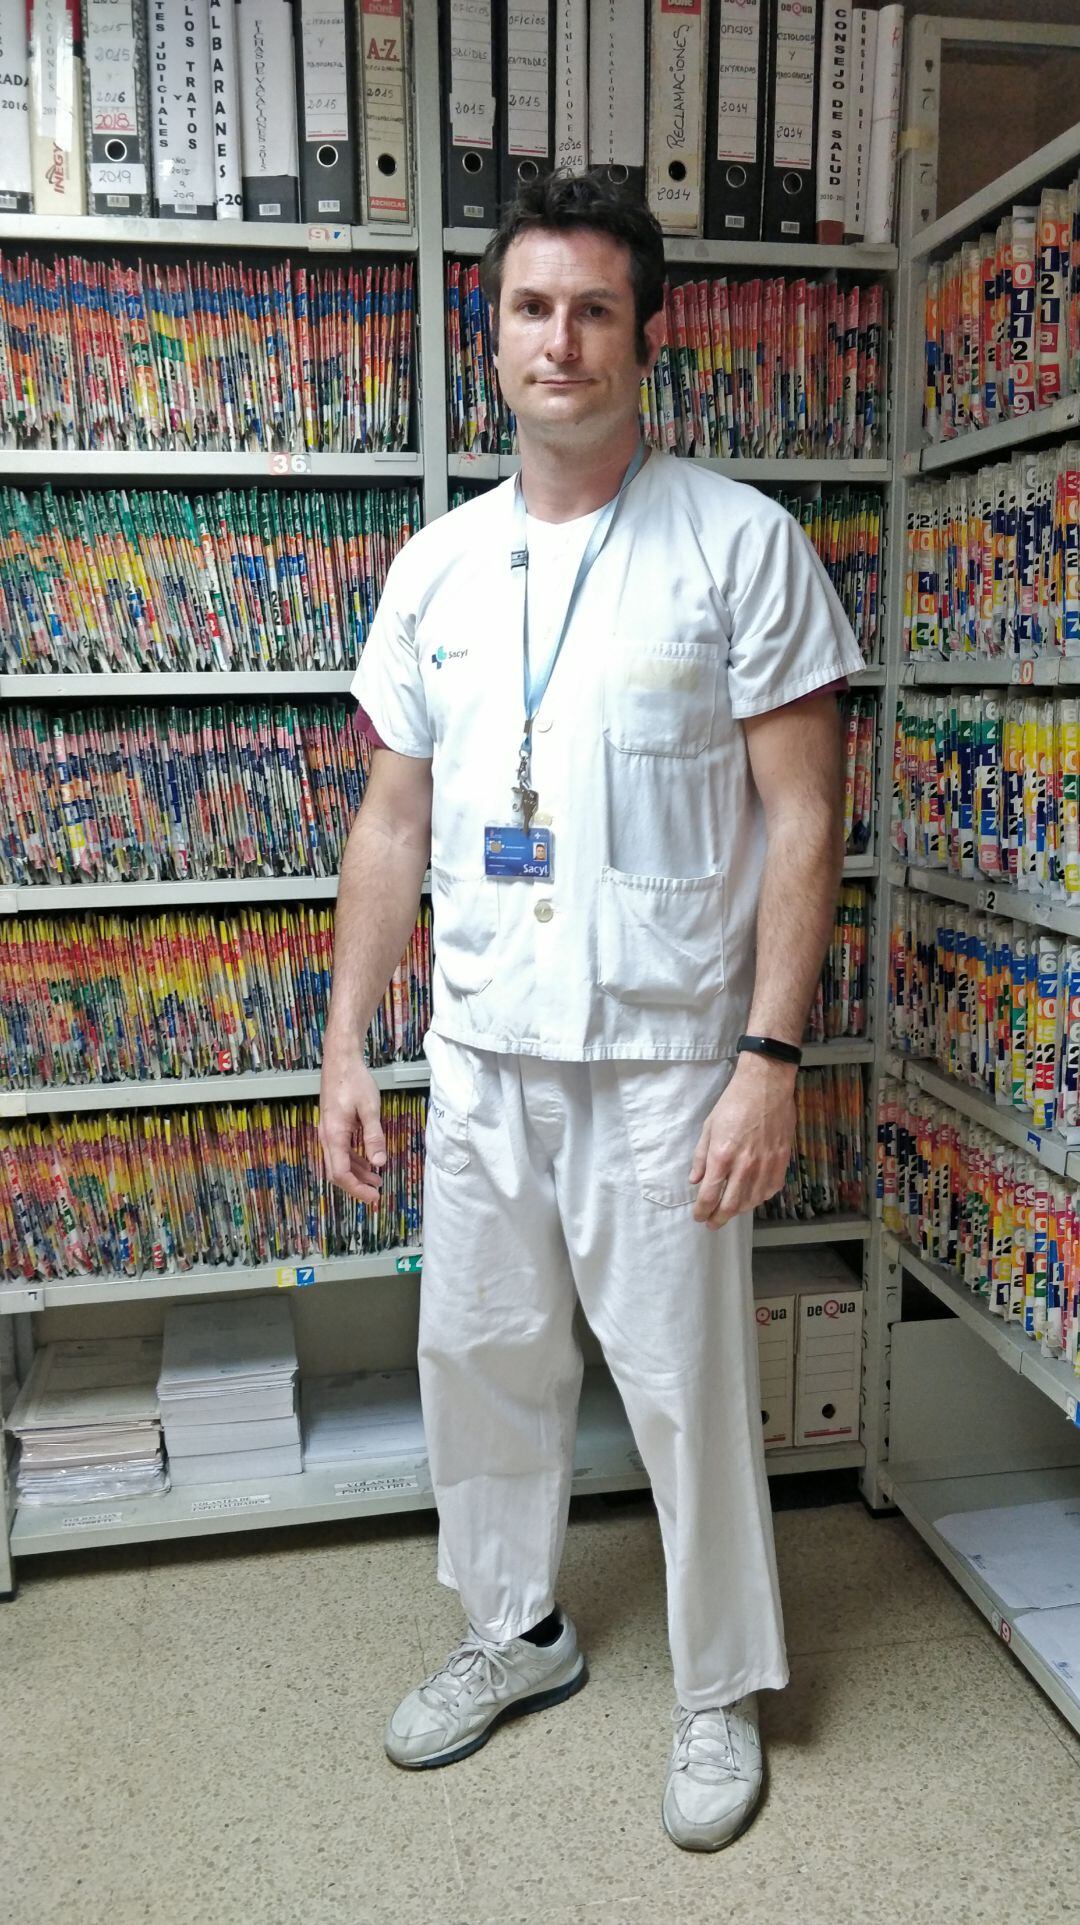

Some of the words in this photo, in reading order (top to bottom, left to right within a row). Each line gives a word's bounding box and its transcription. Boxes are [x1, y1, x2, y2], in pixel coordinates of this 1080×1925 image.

[832, 9, 847, 90] CONSEJO
[667, 24, 690, 149] RECLAMACIONES
[156, 41, 168, 148] JUDICIALES
[509, 94, 541, 107] 2015
[2, 101, 28, 111] 2016
[186, 61, 198, 150] TRATOS
[455, 101, 486, 115] 2015
[720, 101, 748, 113] 2014
[832, 99, 844, 120] DE
[95, 112, 131, 129] 2018
[776, 126, 803, 138] 2014
[829, 130, 842, 186] SALUD
[53, 141, 64, 194] INEGY
[99, 169, 131, 184] 2019
[657, 187, 691, 201] 2014
[448, 649, 468, 660] Sacyl
[523, 863, 548, 876] Sacyl
